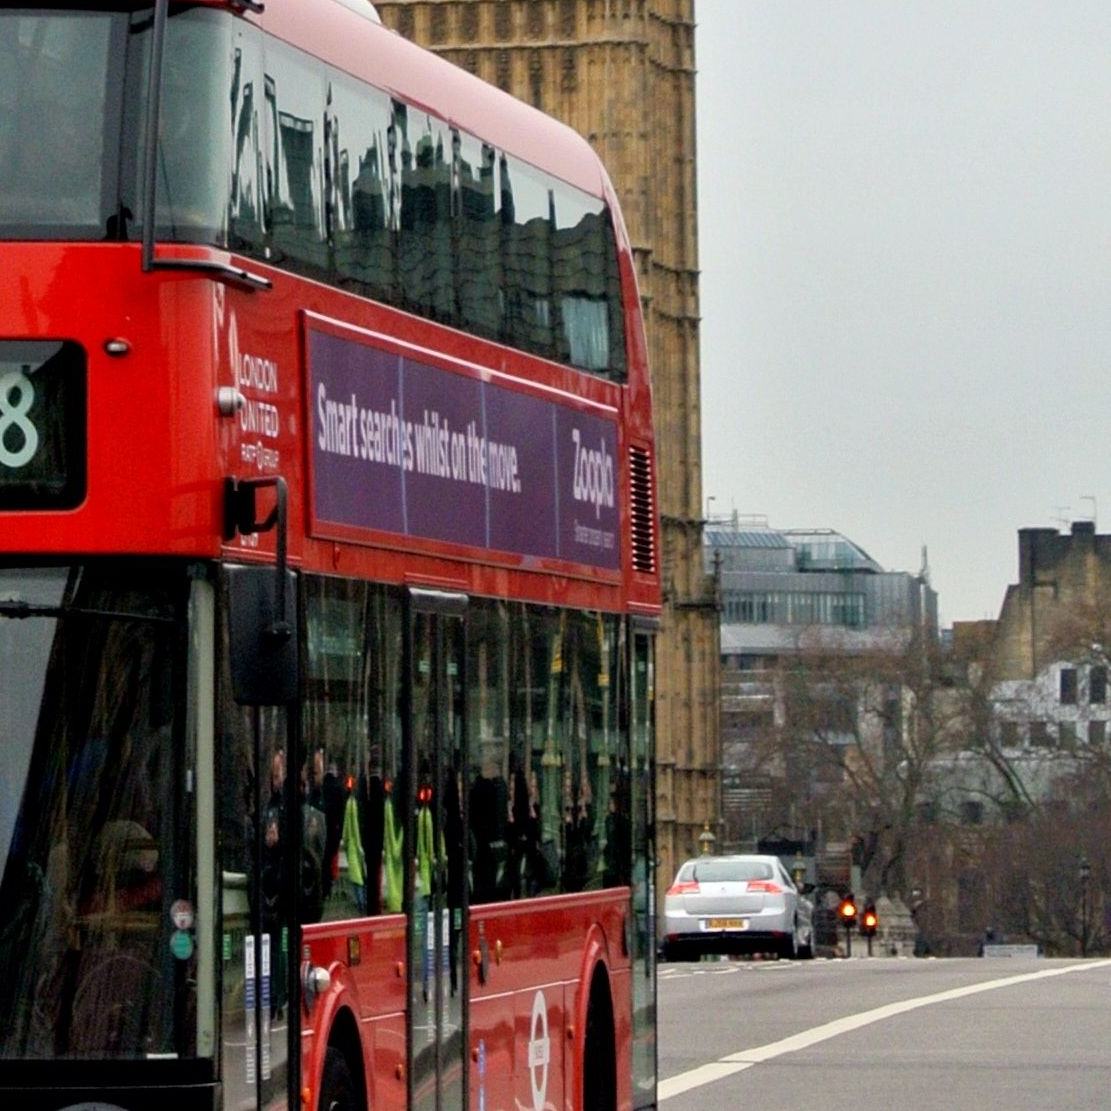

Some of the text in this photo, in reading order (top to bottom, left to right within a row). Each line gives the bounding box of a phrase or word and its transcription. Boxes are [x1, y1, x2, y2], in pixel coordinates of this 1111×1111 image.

[238, 352, 277, 393] LONDON
[240, 399, 279, 438] UNITED
[318, 382, 521, 493] Smart searches whilst on the move.
[572, 428, 614, 520] Zoopla
